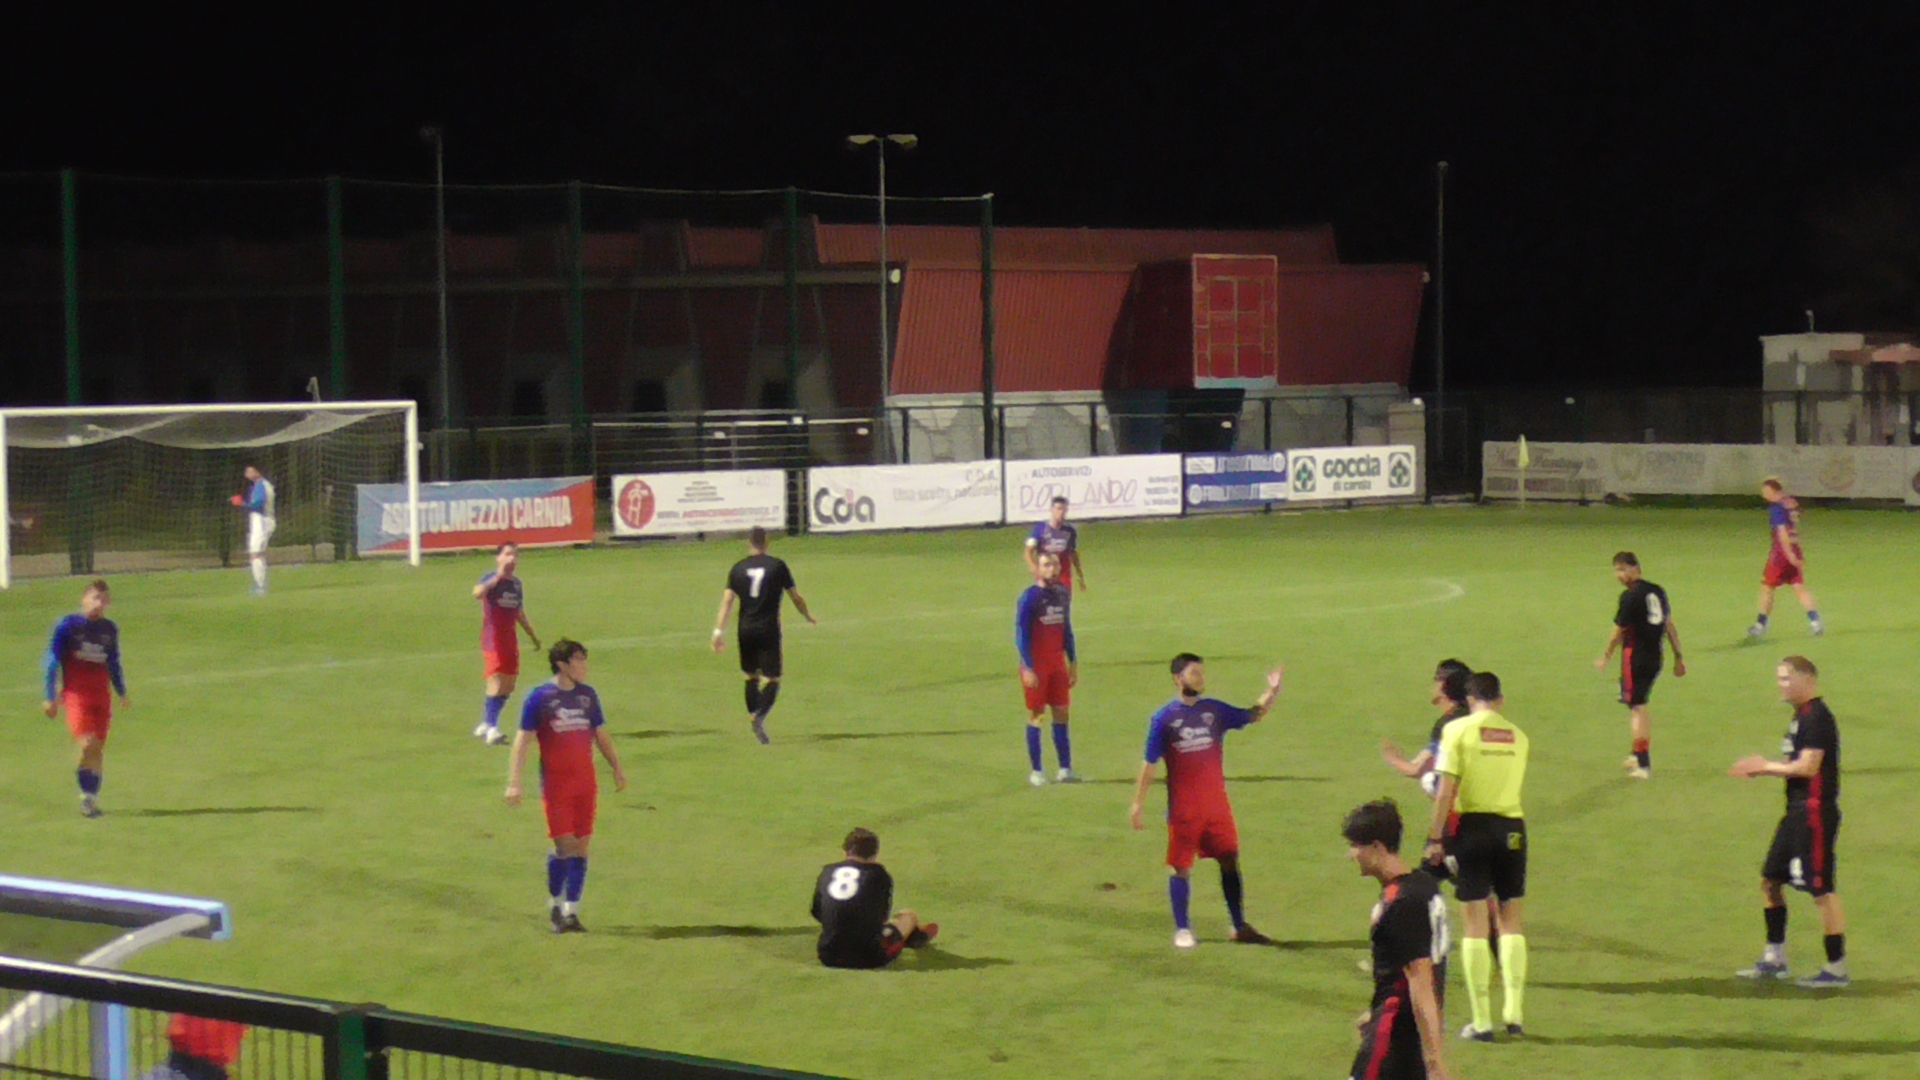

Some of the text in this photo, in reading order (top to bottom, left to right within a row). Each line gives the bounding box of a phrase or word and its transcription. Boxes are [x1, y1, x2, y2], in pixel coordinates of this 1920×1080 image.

[512, 494, 572, 529] CARNIA
[746, 567, 765, 598] 7
[1645, 592, 1663, 625] 9
[828, 866, 861, 901] 8
